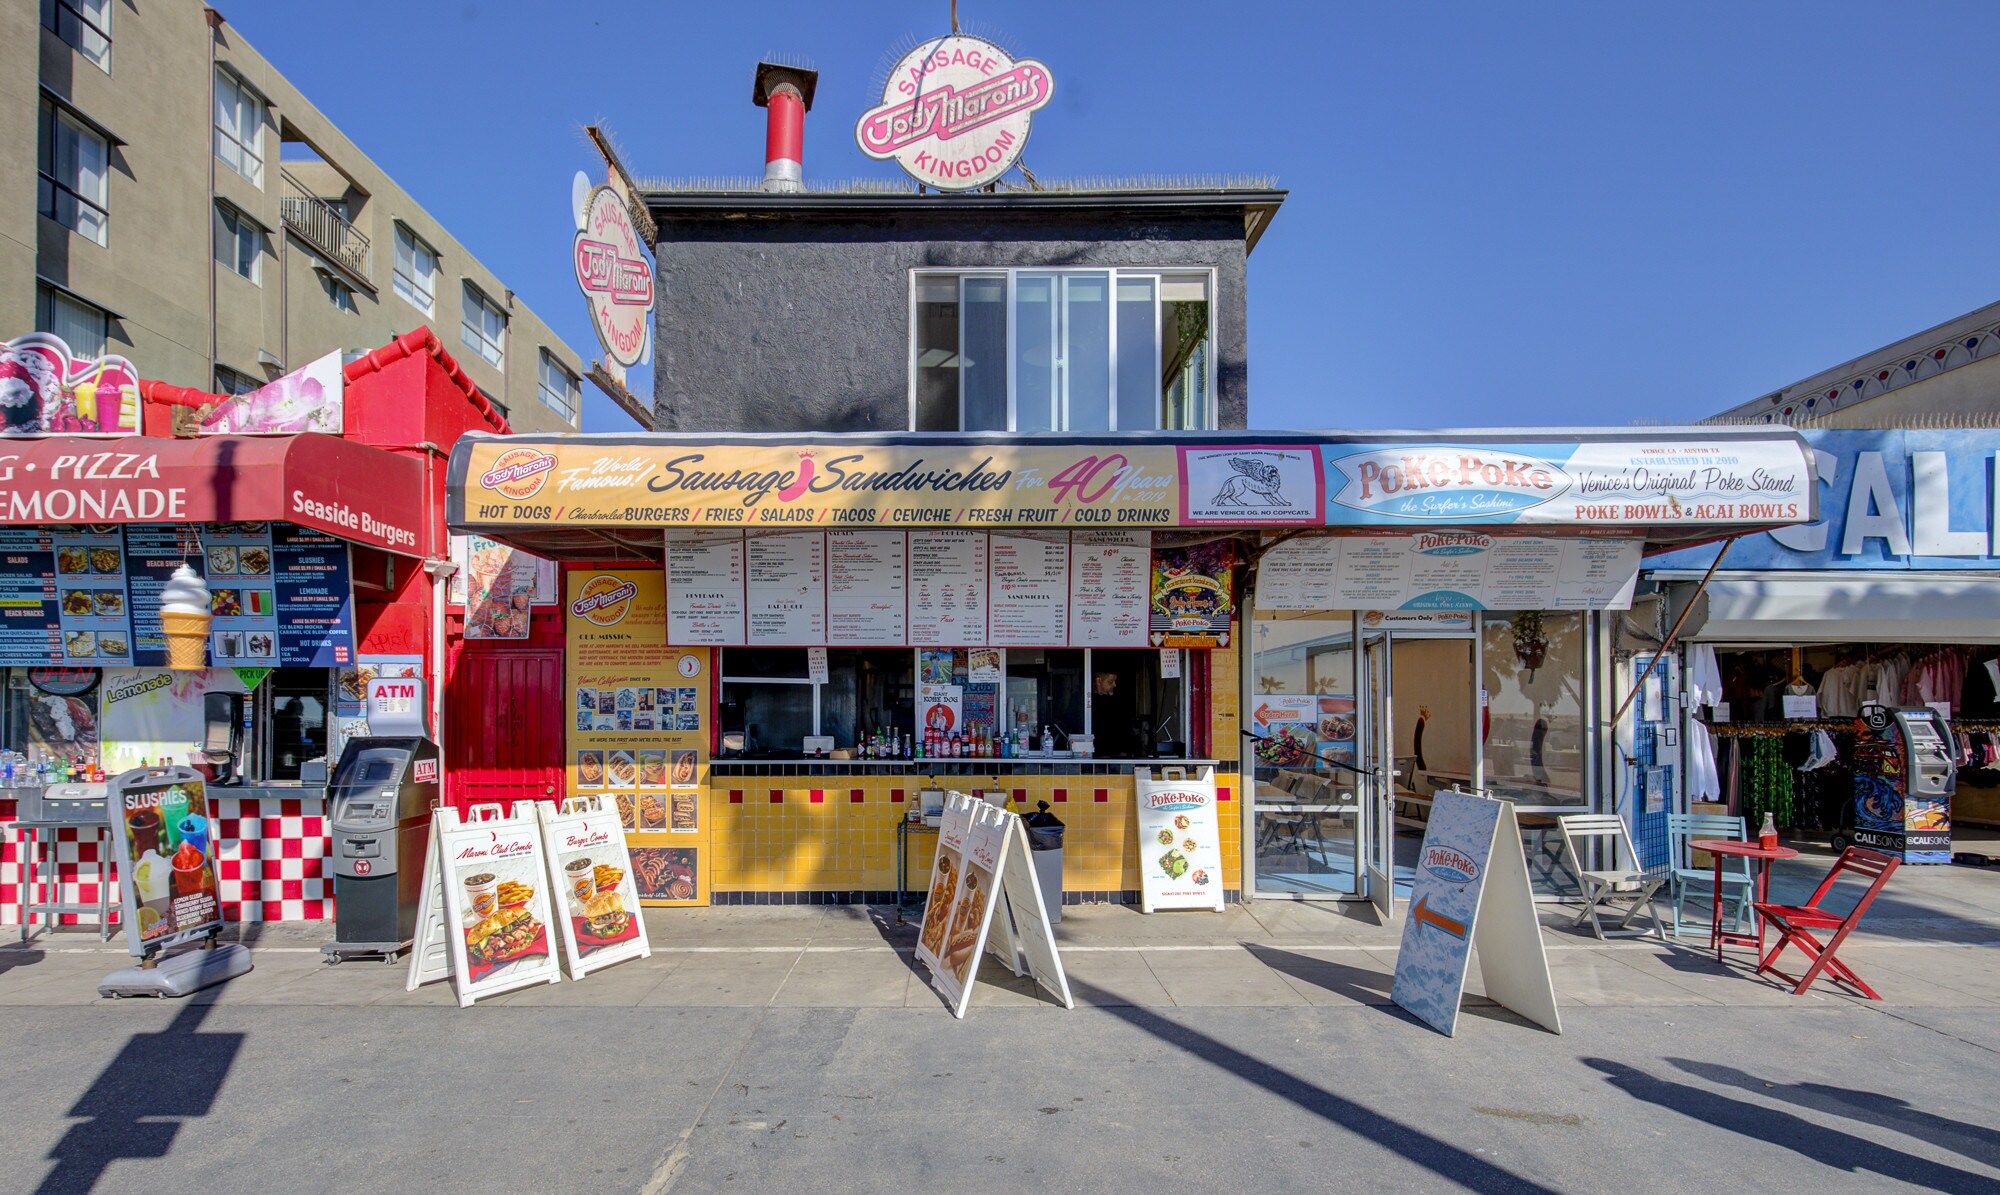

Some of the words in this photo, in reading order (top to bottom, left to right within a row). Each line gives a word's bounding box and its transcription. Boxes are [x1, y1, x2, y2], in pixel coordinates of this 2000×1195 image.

[898, 48, 998, 96] SAUSAGE
[866, 100, 940, 145] Jody
[926, 67, 1041, 133] Maroni's
[913, 129, 1016, 178] KINGDOM
[594, 202, 636, 257] SAUSAGE
[579, 245, 612, 286] Jody
[606, 250, 651, 300] Maroni's
[601, 305, 642, 353] KINGDOM
[51, 452, 160, 480] PIZZA
[498, 451, 537, 467] SAUSAGE
[592, 456, 651, 474] World
[1630, 457, 1700, 466] ESTABLISHED
[1701, 457, 1713, 465] IN
[1715, 456, 1739, 465] 2010
[484, 466, 513, 485] Jody
[511, 456, 555, 480] Maroni's
[557, 463, 656, 494] Famous!
[647, 454, 796, 508] Sausage
[808, 454, 1013, 493] Sandwiches
[1015, 468, 1046, 491] For
[1047, 453, 1128, 505] 40
[1109, 466, 1174, 503] Years
[503, 478, 542, 496] KINGDOM
[1578, 468, 1630, 494] Venice's
[1633, 467, 1696, 497] Original
[1701, 468, 1745, 492] Poke
[1746, 468, 1795, 493] Stand
[479, 504, 508, 520] HOT
[513, 504, 551, 520] DOGS
[568, 507, 626, 521] Charbroiled
[625, 508, 689, 522] BURGERS
[705, 508, 744, 522] FRIES
[760, 508, 814, 522] SALADS
[832, 508, 876, 522] TACOS
[892, 508, 952, 522] CEVICHE
[968, 508, 1012, 522] FRESH
[1018, 508, 1059, 522] FRUIT
[1074, 508, 1111, 522] COLD
[1117, 508, 1170, 523] DRINKS
[1400, 500, 1417, 512] the
[1420, 496, 1466, 515] Surfer's
[1470, 494, 1514, 510] Sashimi
[1575, 505, 1620, 520] POKE
[1624, 505, 1682, 520] BOWLS
[1685, 508, 1693, 517] &
[1694, 504, 1734, 519] ACAI
[1738, 504, 1798, 519] BOWLS
[292, 490, 359, 529] Seaside
[361, 515, 416, 548] Burgers
[146, 560, 165, 568] BEACH
[584, 579, 618, 596] SAUSAGE
[574, 595, 600, 613] Jody
[597, 584, 634, 608] Maroni's
[592, 605, 625, 623] KINGDOM
[240, 669, 254, 679] PICK
[255, 669, 265, 679] UP
[578, 676, 597, 686] Venice
[598, 676, 628, 687] California
[106, 674, 172, 704] Lemonade
[374, 685, 415, 698] ATM
[416, 762, 435, 775] ATM
[125, 790, 187, 811] SLUSHIES
[456, 846, 489, 860] Maroni
[491, 844, 509, 857] Club
[509, 841, 534, 852] Combo
[566, 835, 589, 848] Burger
[590, 832, 609, 842] Combo
[1906, 836, 1950, 846] @CALISONS
